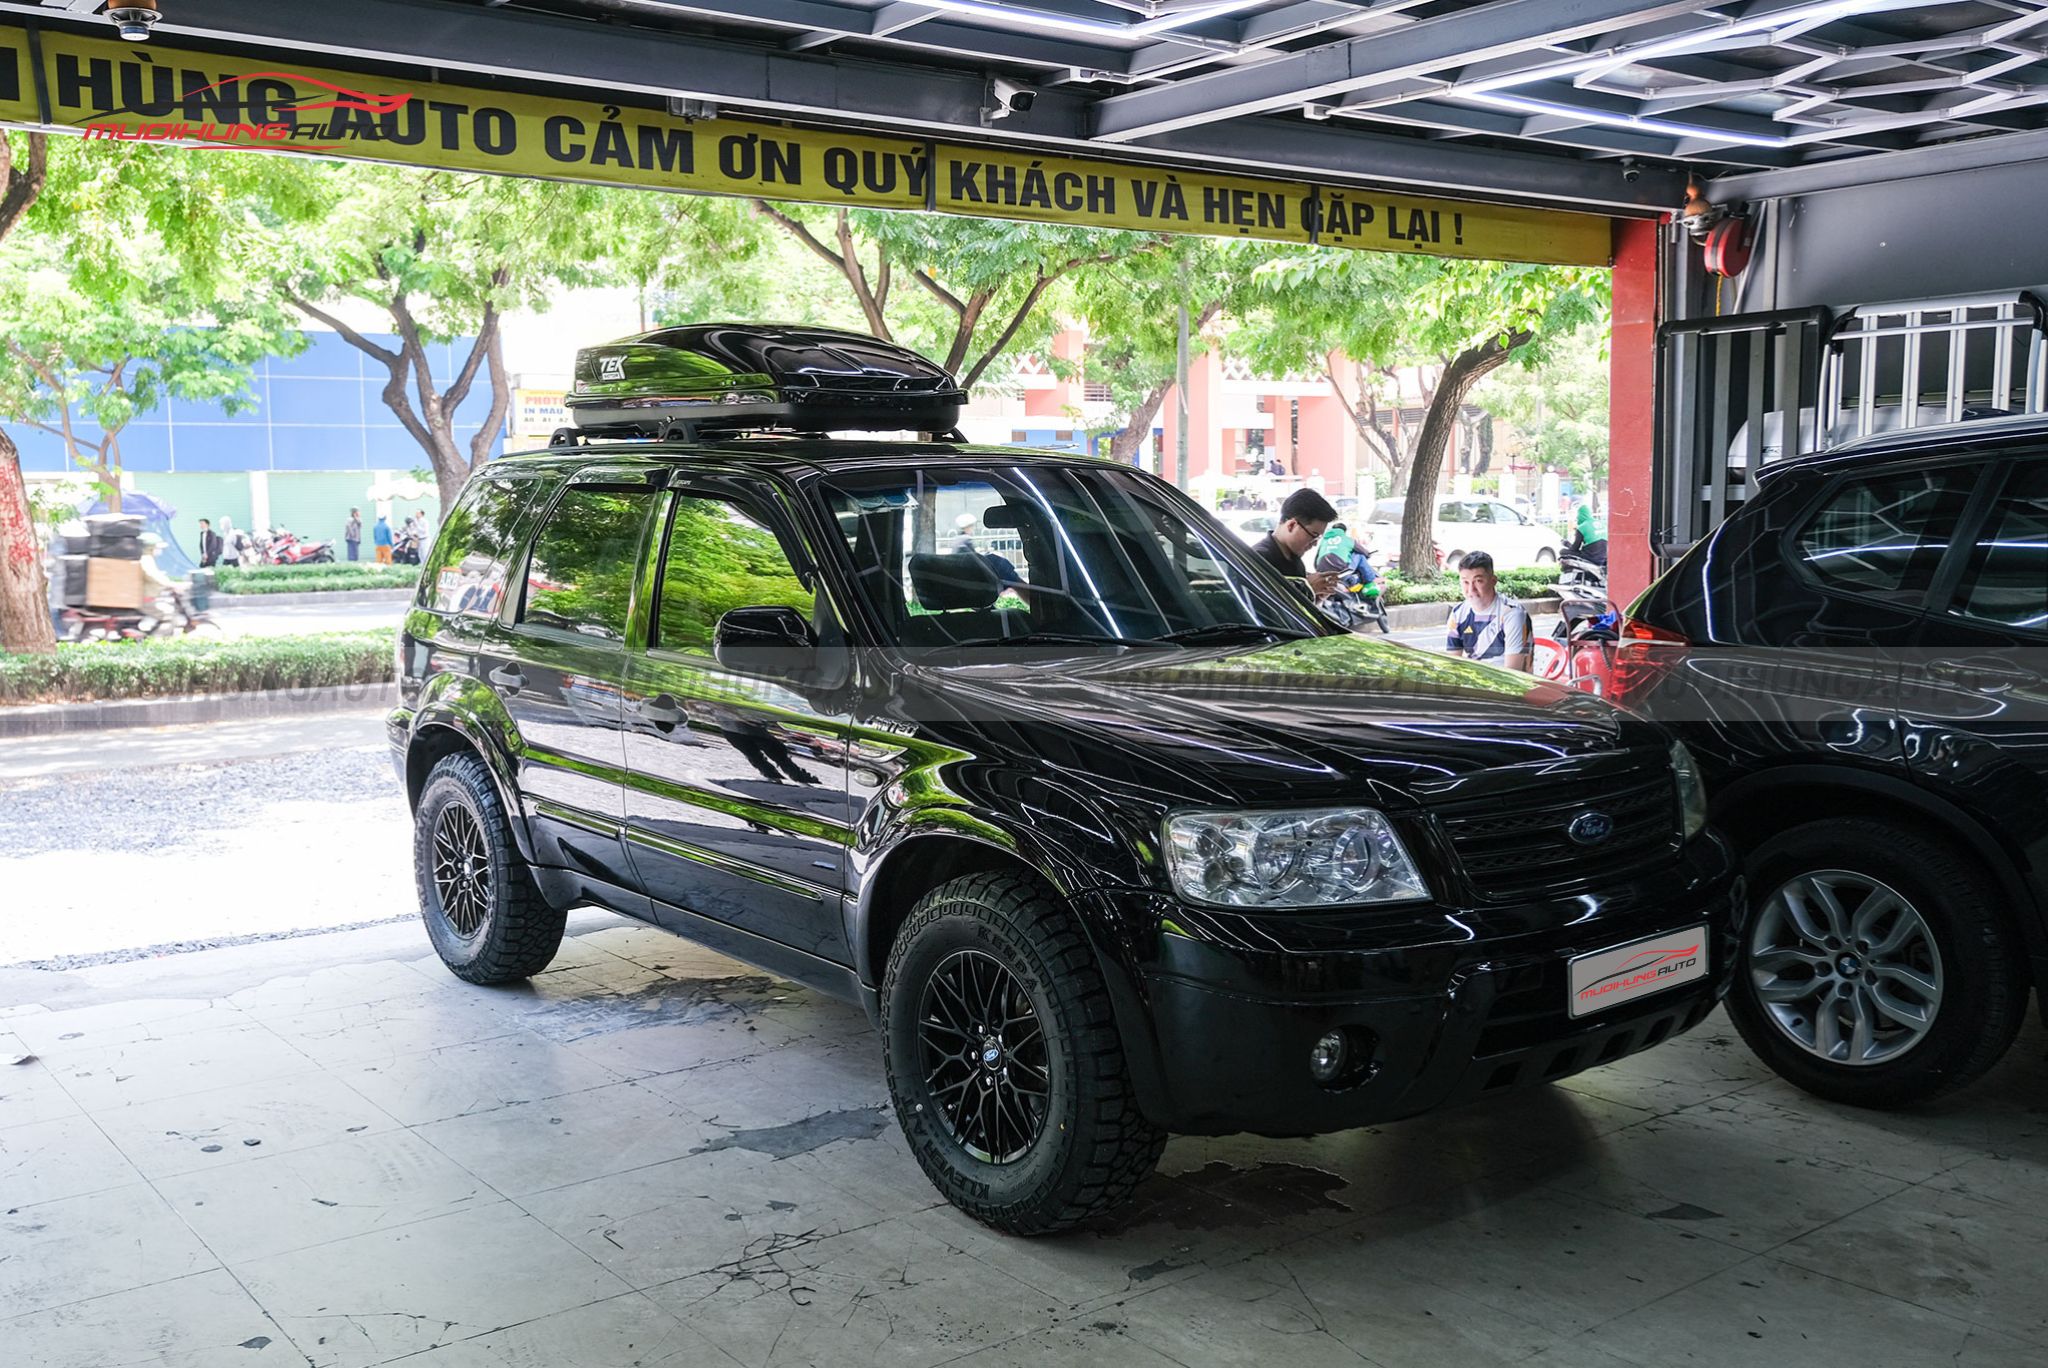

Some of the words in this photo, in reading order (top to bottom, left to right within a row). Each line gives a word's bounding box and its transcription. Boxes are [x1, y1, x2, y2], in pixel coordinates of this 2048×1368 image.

[56, 51, 297, 132] HÙNG
[326, 91, 517, 156] AUTO
[545, 104, 694, 174] CẢM
[719, 133, 801, 185] ƠN
[823, 146, 929, 197] QUÝ
[950, 160, 1117, 215] KHÁCH
[1131, 168, 1189, 221] VÀ
[1203, 186, 1286, 234] HẸN
[1300, 192, 1375, 243] GẶP
[1387, 206, 1441, 249] LẠI
[600, 355, 628, 380] TEK
[977, 925, 1038, 993] KENDA
[924, 1139, 990, 1200] KLEVER
